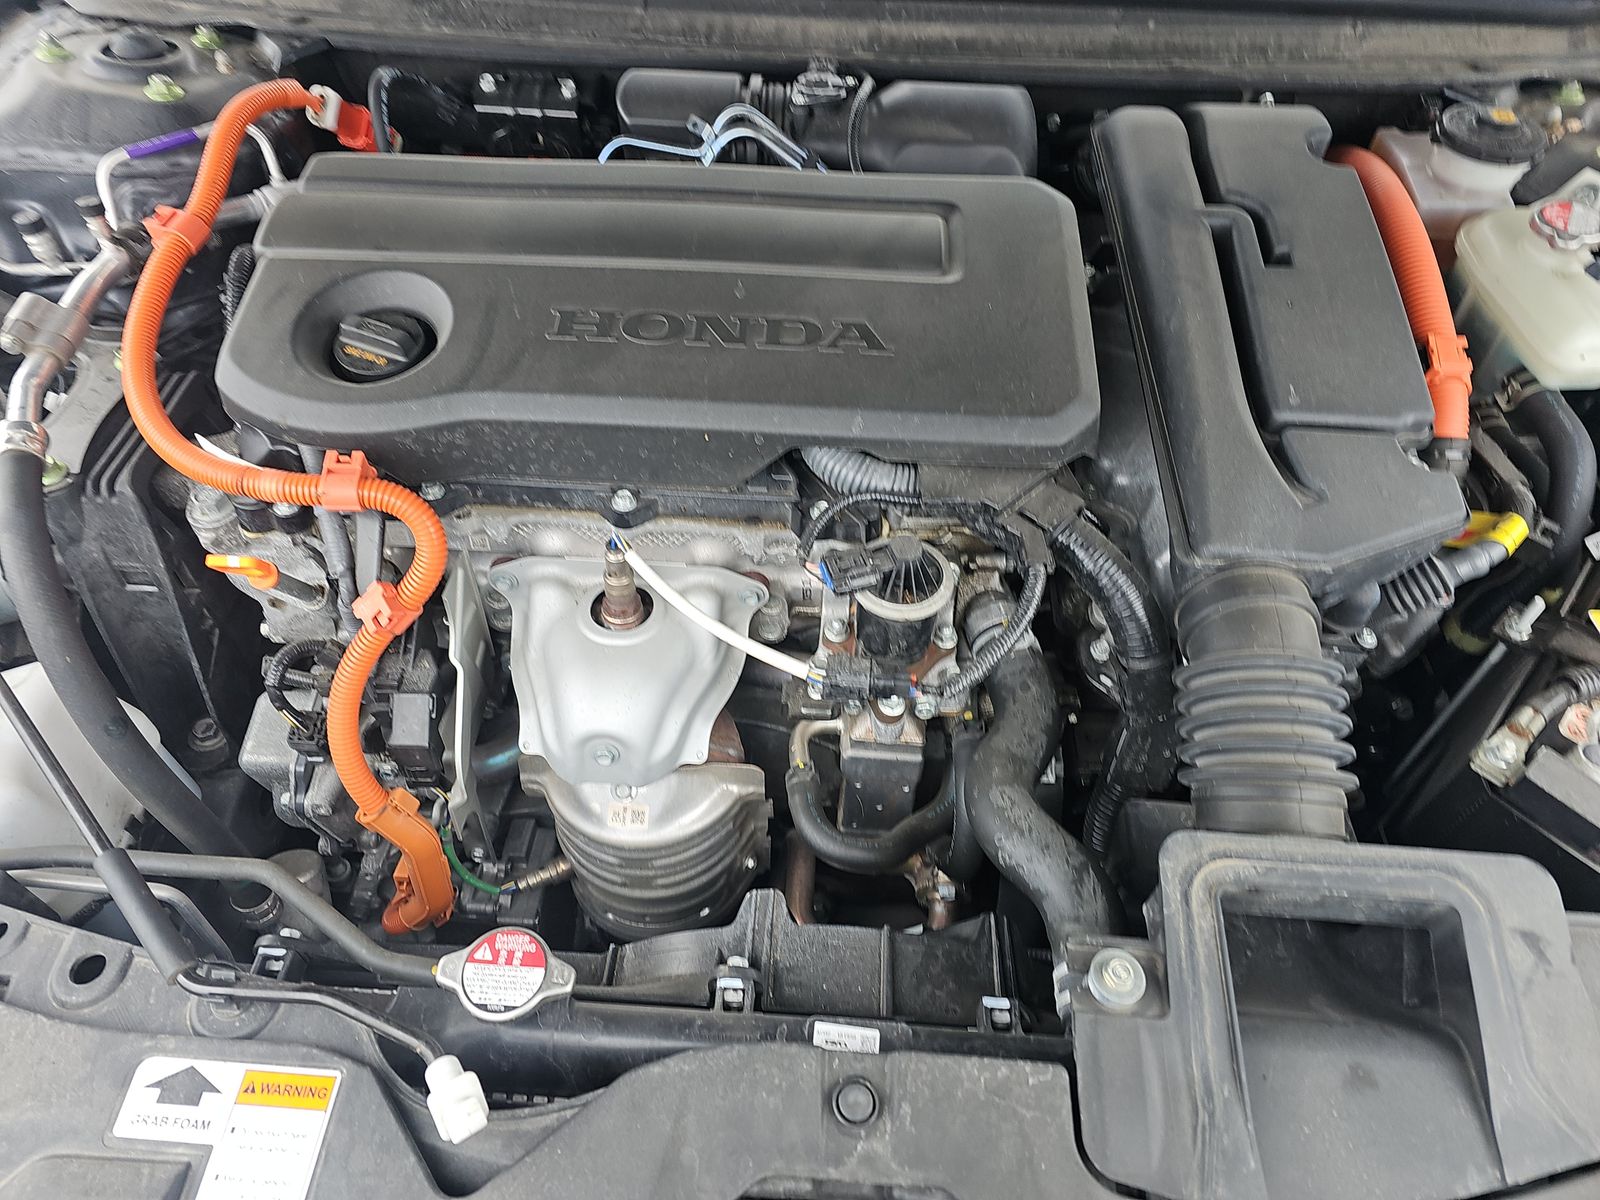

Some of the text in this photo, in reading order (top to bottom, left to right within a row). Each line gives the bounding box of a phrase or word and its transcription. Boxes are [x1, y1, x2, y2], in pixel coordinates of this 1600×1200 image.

[545, 307, 895, 356] HONDA
[260, 1082, 328, 1099] WARNING
[173, 1117, 211, 1130] FOAM
